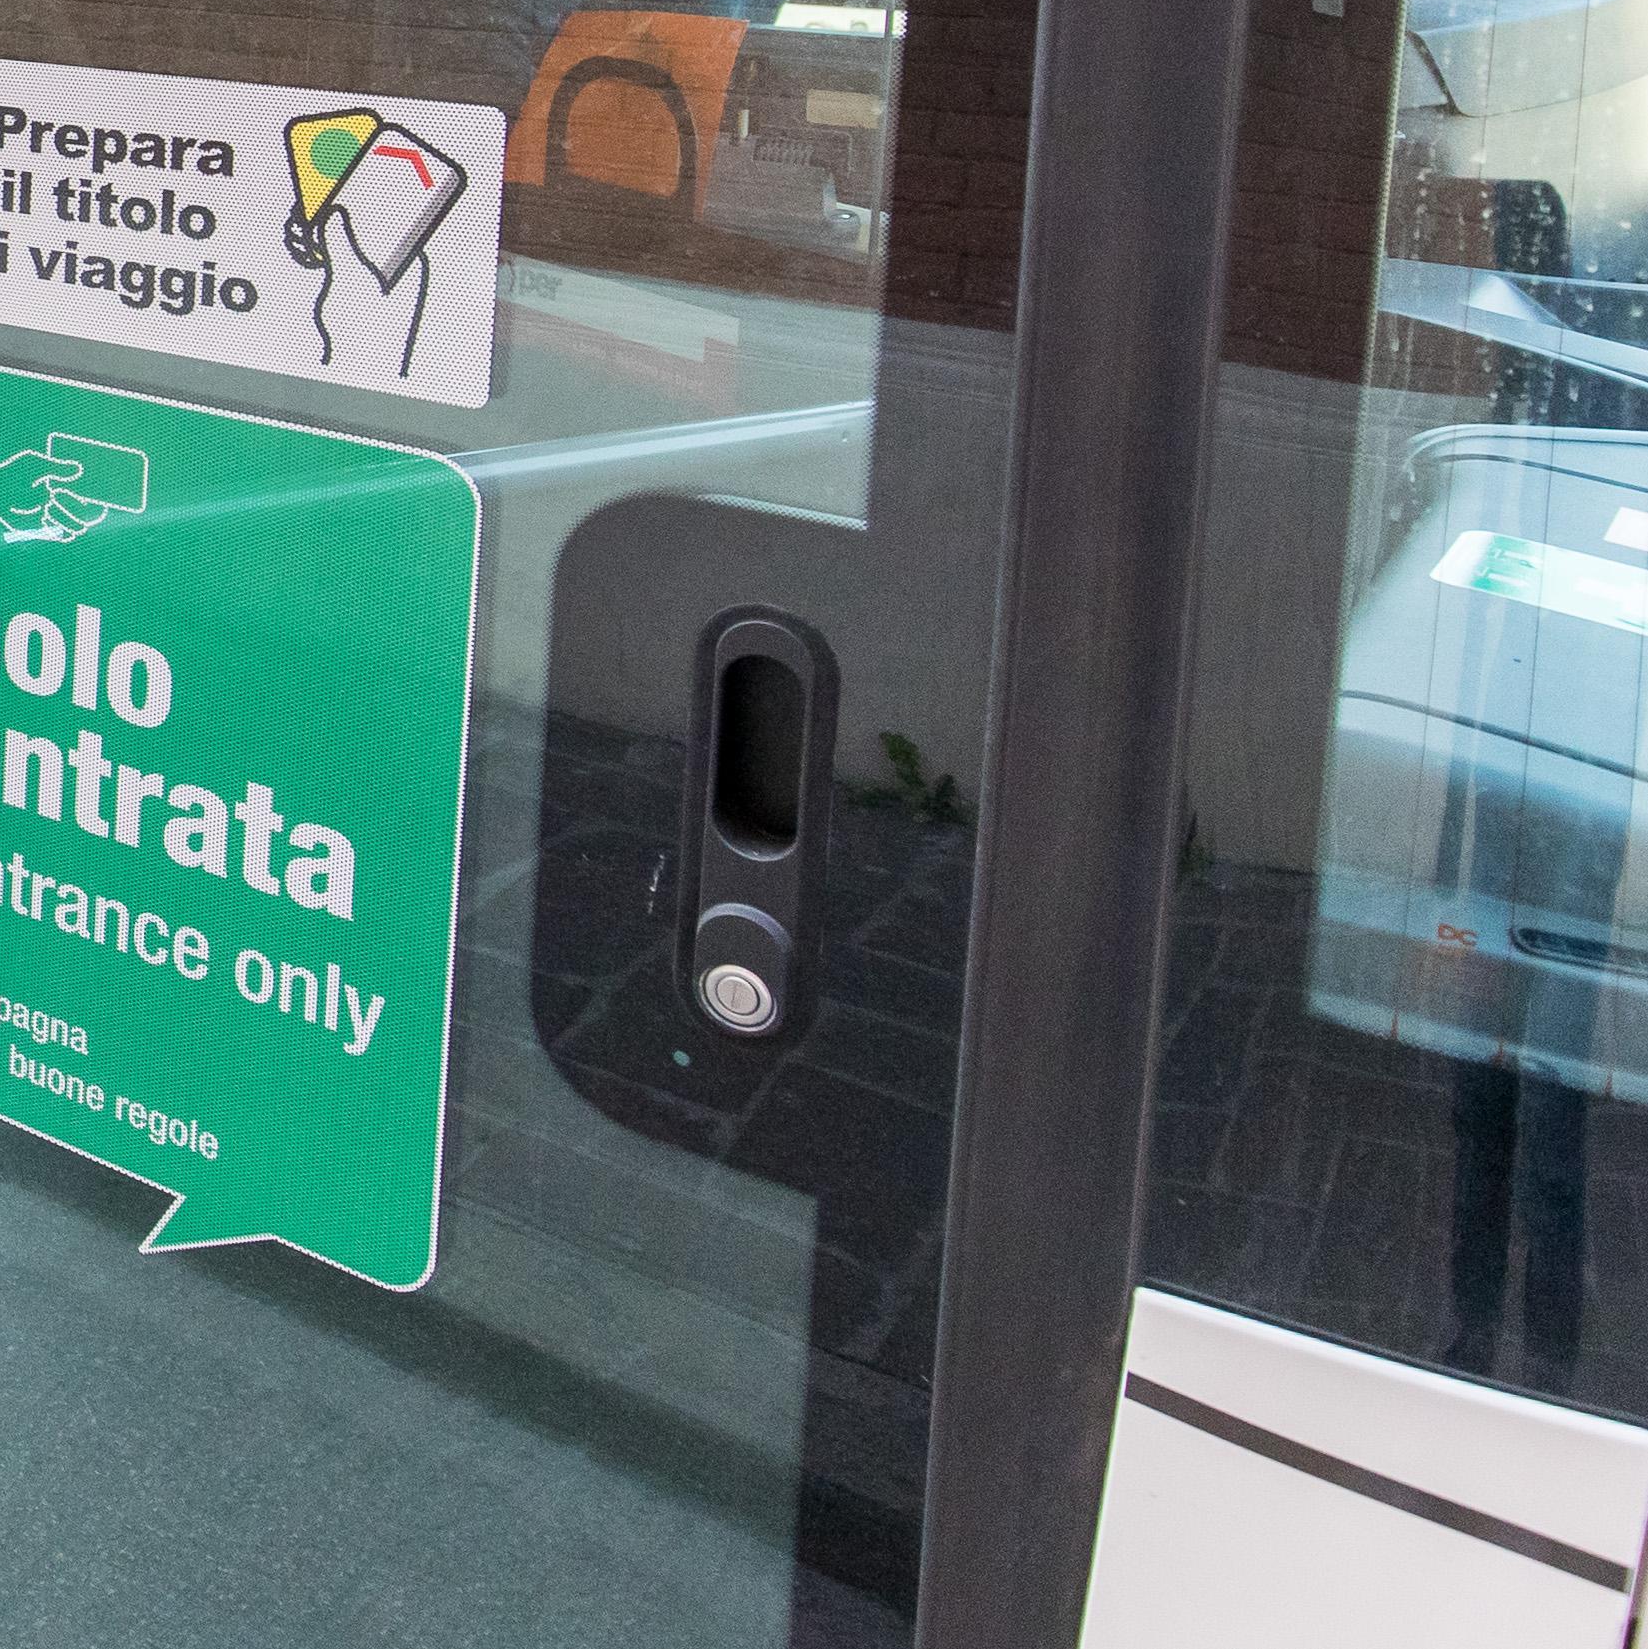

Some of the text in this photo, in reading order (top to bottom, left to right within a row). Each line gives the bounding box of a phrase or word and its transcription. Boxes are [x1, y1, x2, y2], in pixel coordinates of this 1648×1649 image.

[2, 168, 218, 244] il titolo
[29, 242, 260, 318] viaggio
[234, 944, 386, 1058] only
[9, 1048, 105, 1115] buone
[113, 1089, 220, 1162] regole
